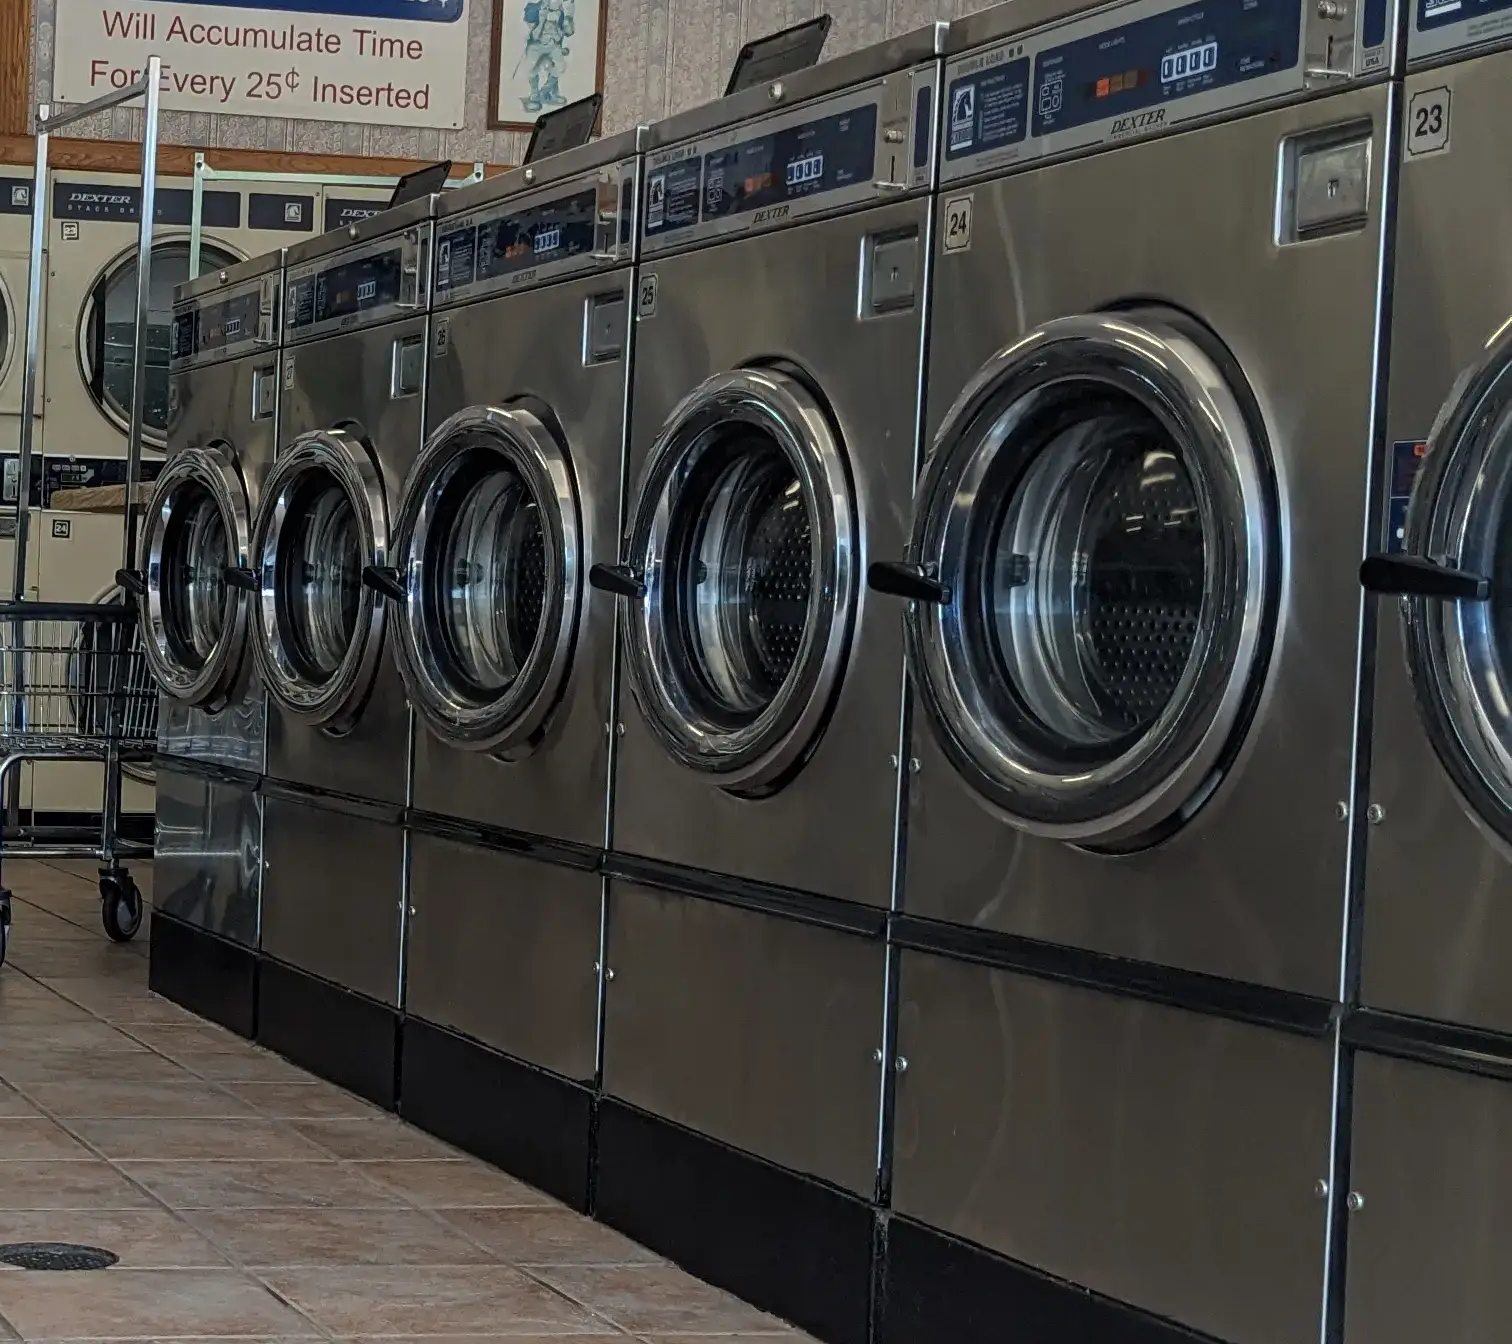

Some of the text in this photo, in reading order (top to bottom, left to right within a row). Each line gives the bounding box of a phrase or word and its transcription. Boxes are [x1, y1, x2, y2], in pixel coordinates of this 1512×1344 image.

[102, 9, 423, 60] Will Accumulate Time
[90, 59, 430, 110] For Every 25¢ Inserted
[1110, 108, 1166, 135] DEXTER
[1414, 103, 1443, 138] 23
[69, 193, 131, 204] DEXTER
[340, 208, 383, 218] DEXT
[753, 205, 790, 224] DEXTER
[949, 210, 967, 236] 24
[641, 284, 655, 306] 25
